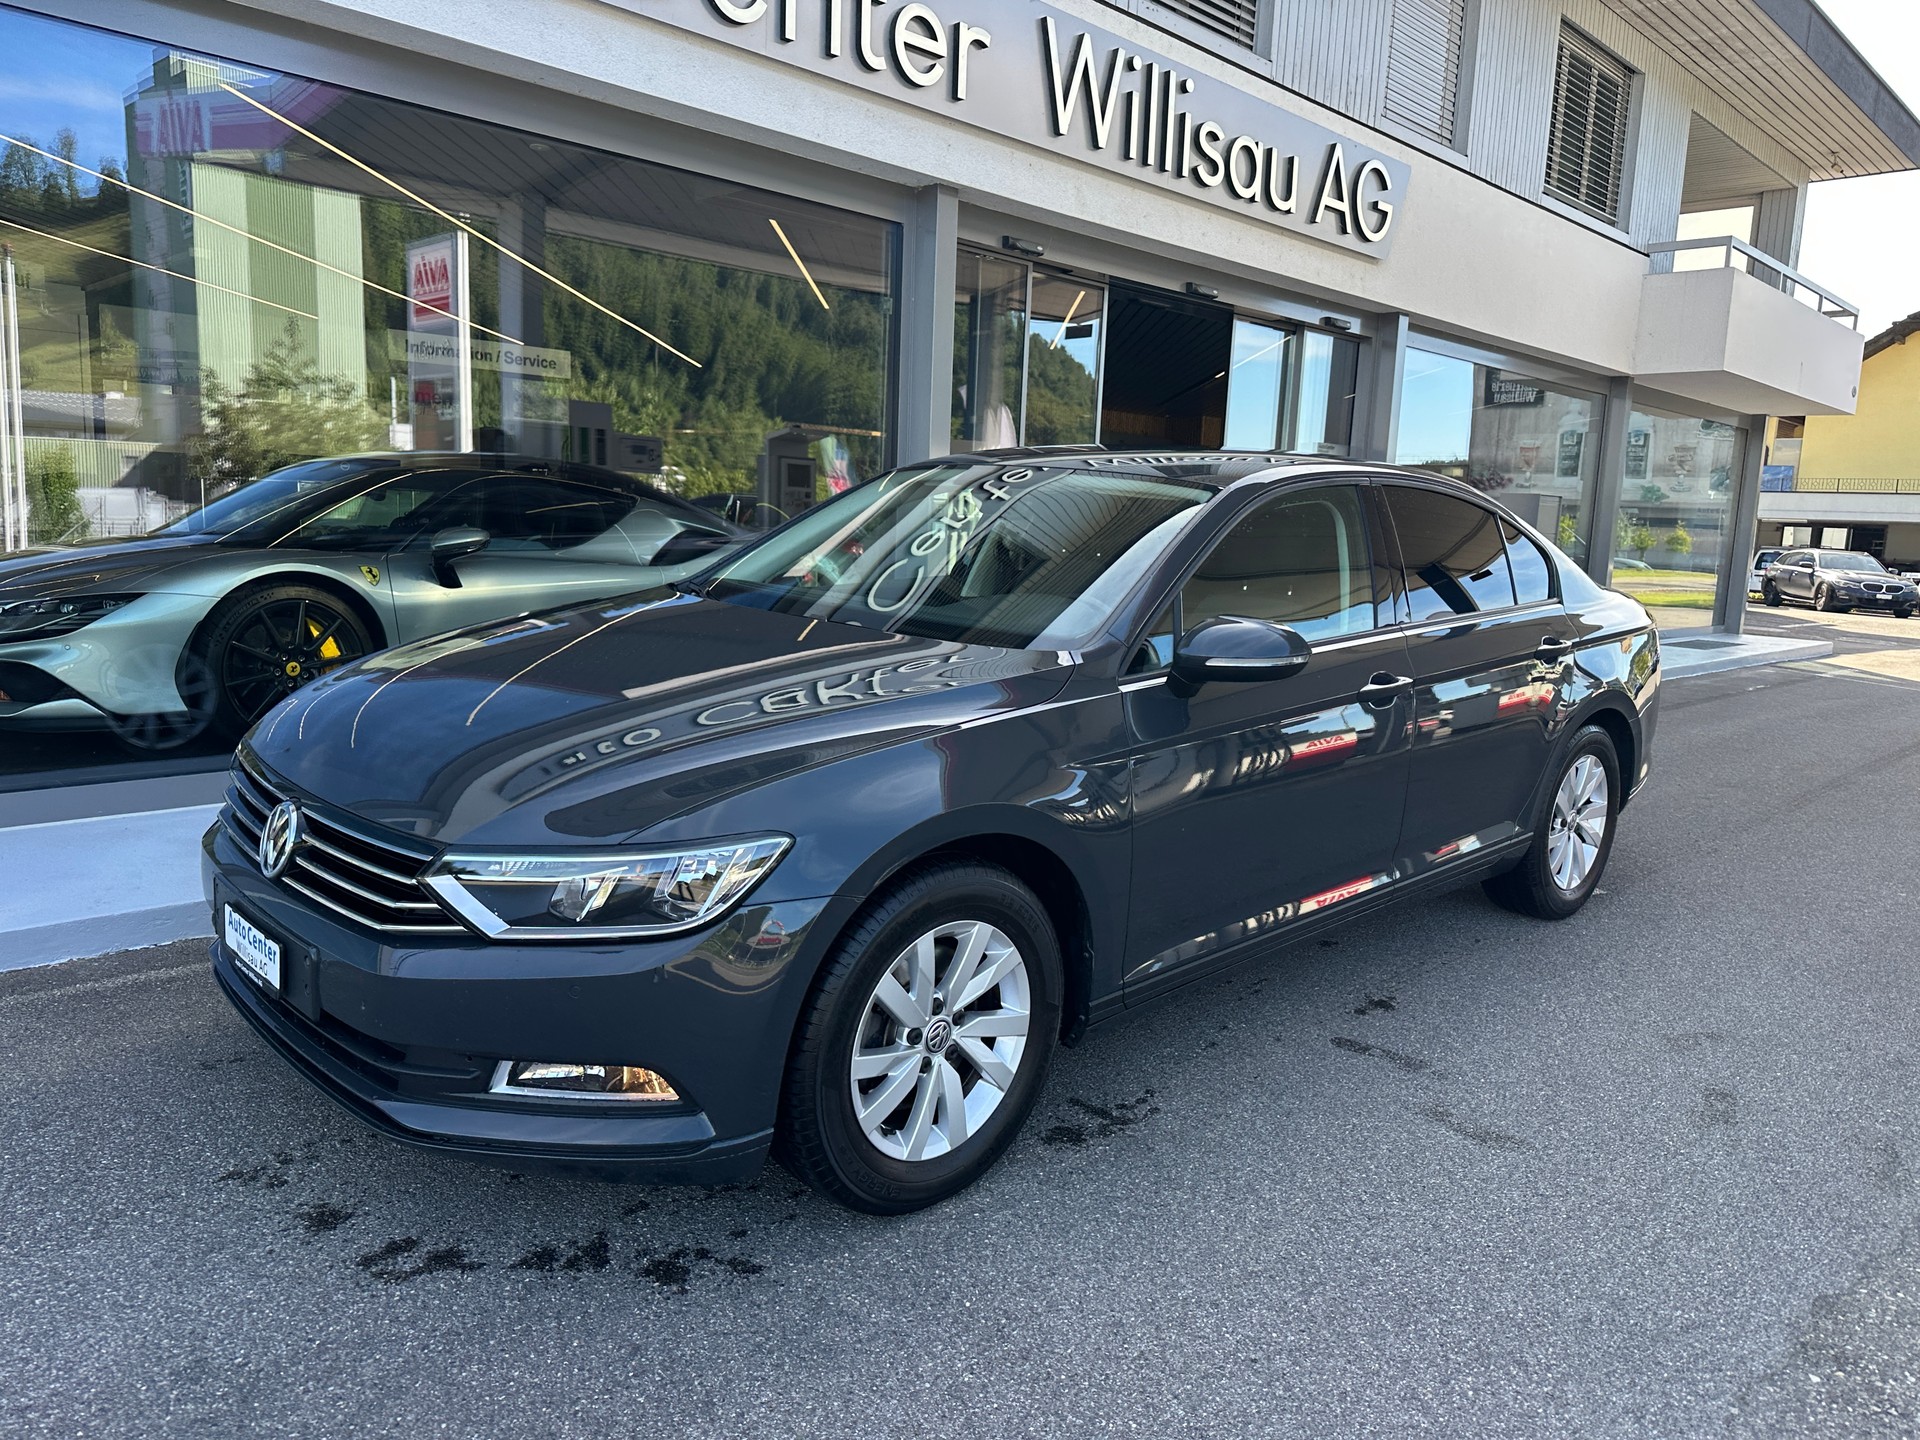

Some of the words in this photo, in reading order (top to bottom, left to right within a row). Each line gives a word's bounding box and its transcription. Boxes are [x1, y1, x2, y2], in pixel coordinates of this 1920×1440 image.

[1041, 16, 1299, 214] Willisau
[1311, 142, 1394, 243] AG
[405, 338, 493, 362] Informion
[504, 350, 557, 370] Service
